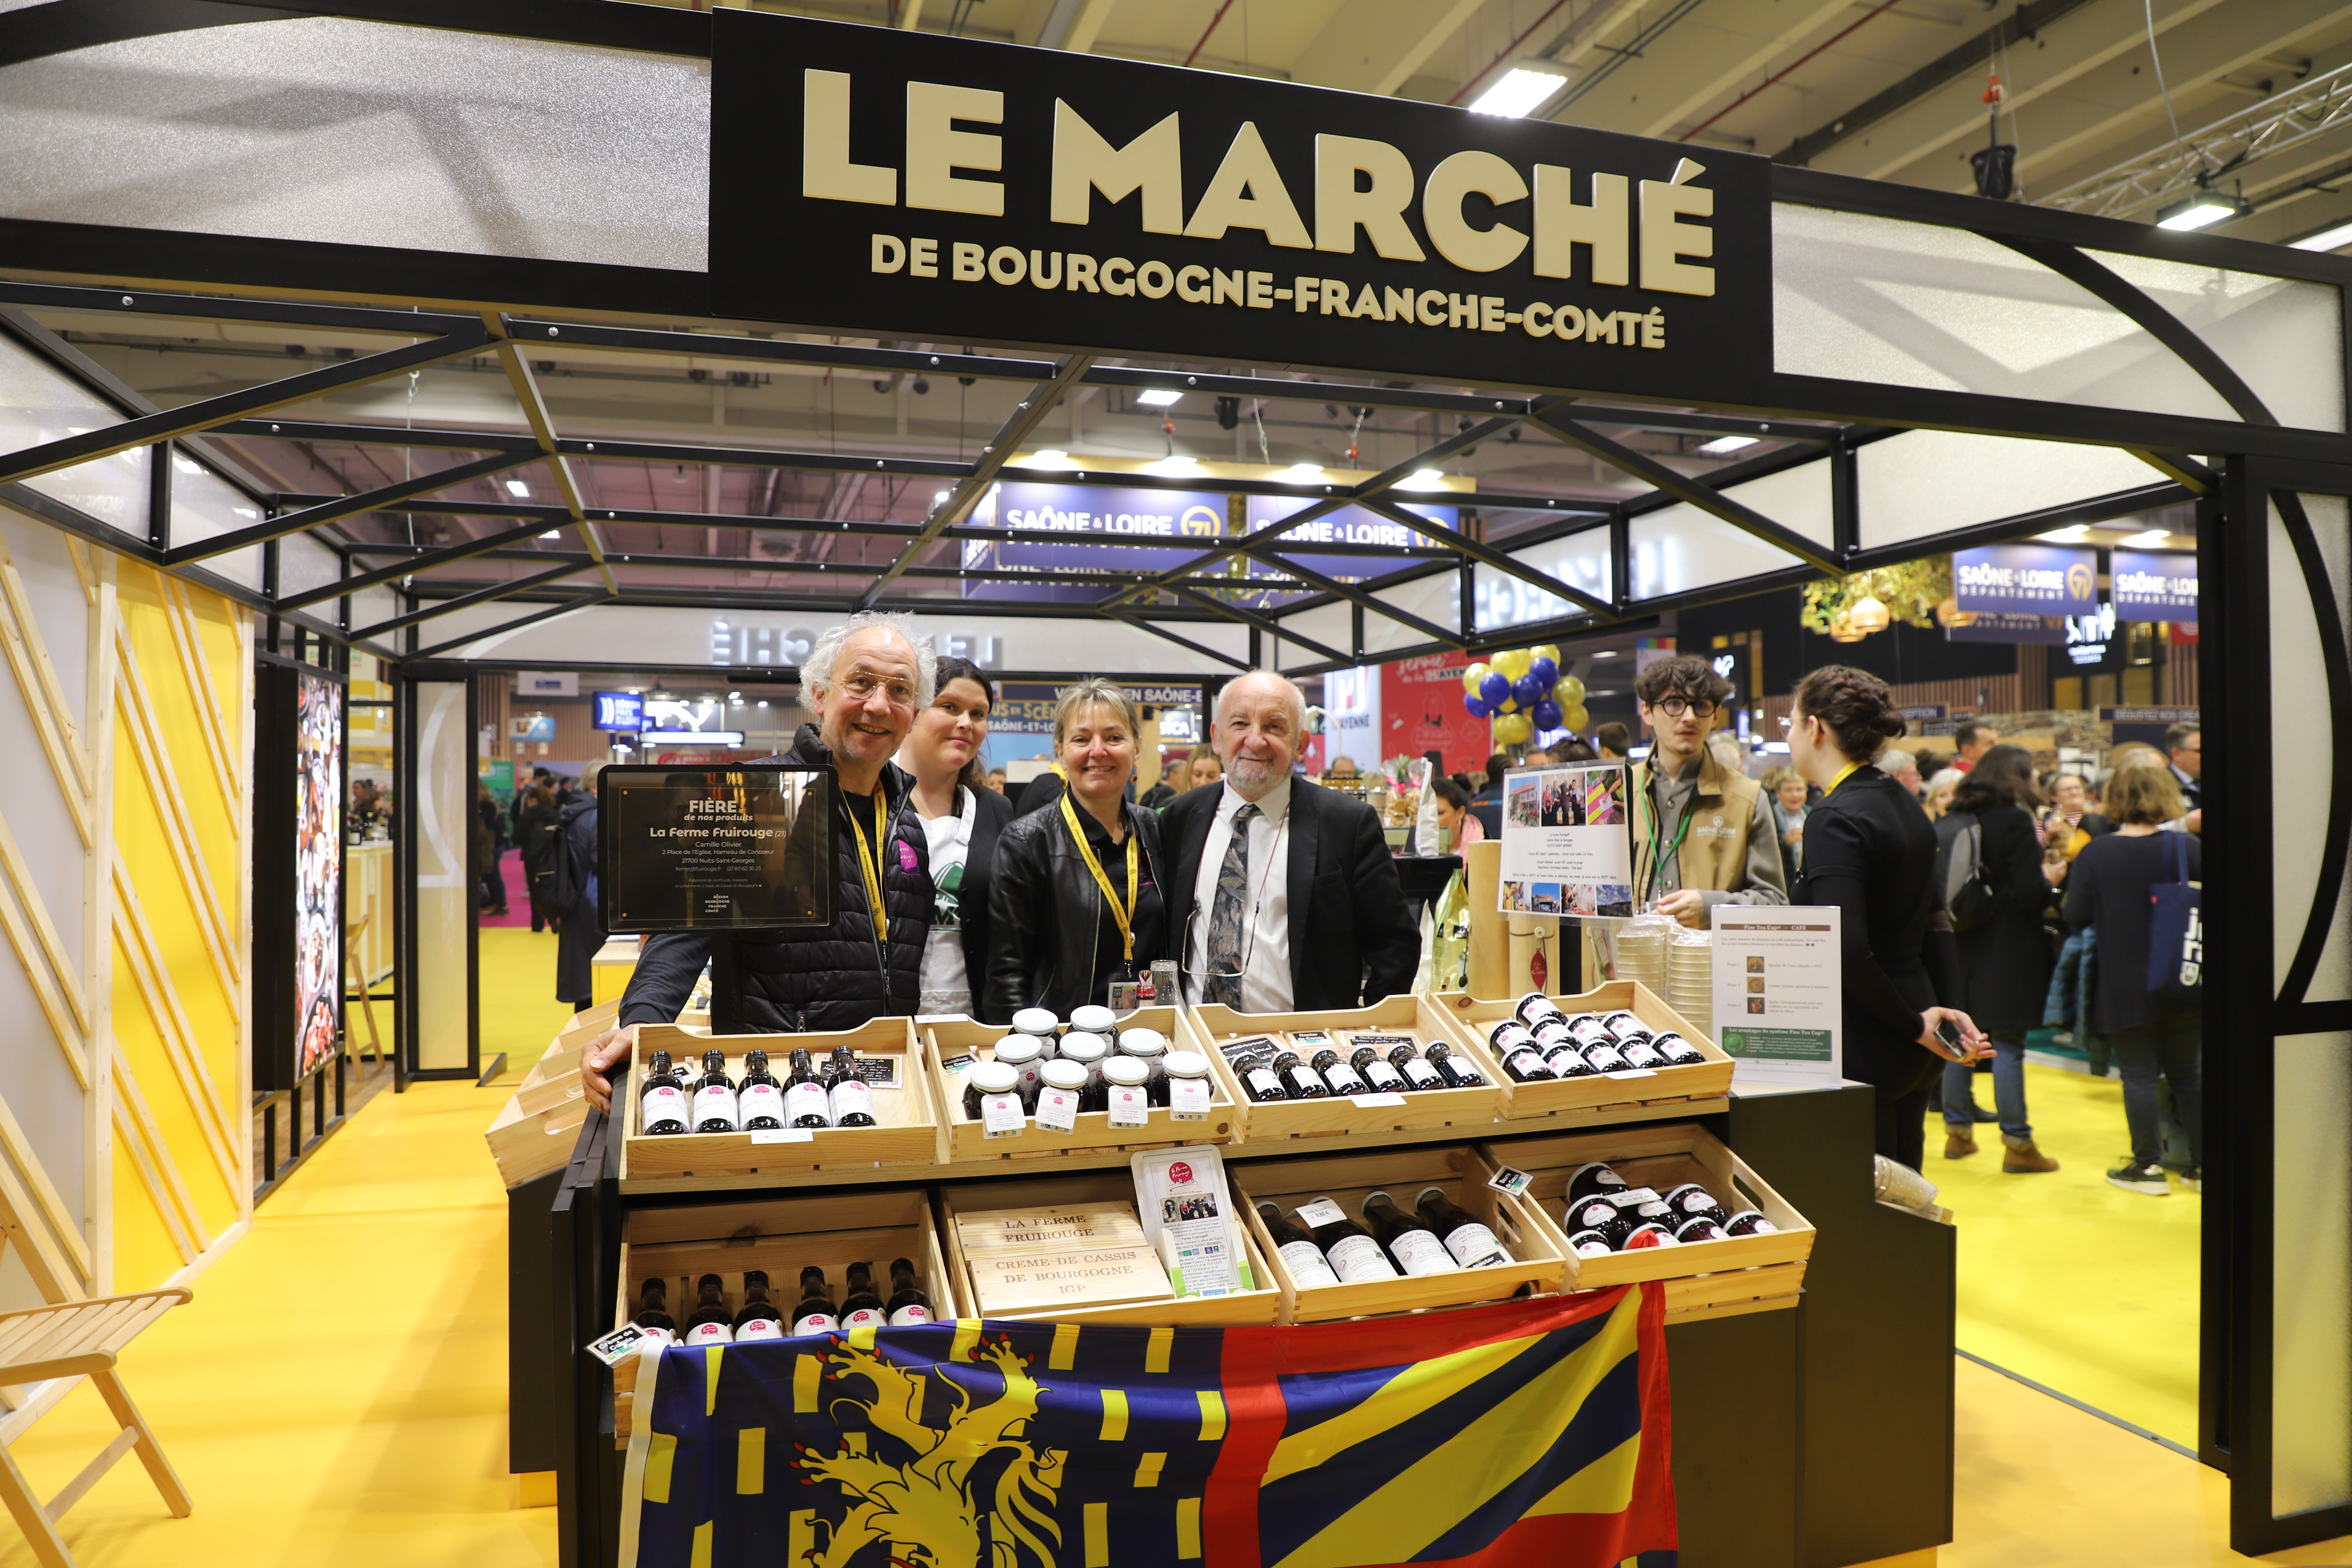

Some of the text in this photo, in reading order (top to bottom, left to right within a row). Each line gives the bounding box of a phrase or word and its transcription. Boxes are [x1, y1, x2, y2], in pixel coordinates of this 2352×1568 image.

[803, 68, 1715, 297] LE MARCHÉ
[871, 234, 1665, 349] DE BOURGOGNE-FRANCHE-COMTÉ
[1007, 505, 1091, 531] SAÔNE
[1105, 513, 1173, 535] LOIRE
[1346, 524, 1408, 547] LOIRE
[1958, 563, 2014, 586] SAÔNE
[2020, 569, 2064, 590] LOIRE
[2116, 571, 2198, 596] SAÔNE LOI
[2116, 594, 2195, 606] DEPARTEME
[1144, 687, 1202, 703] SAÔNE-E
[987, 721, 1055, 731] SAÔNE-ET-LO
[650, 828, 665, 837] La
[669, 828, 709, 837] Ferme
[713, 827, 773, 839] Fruirouge
[1251, 1044, 1272, 1053] local
[943, 1057, 968, 1065] Ketchup
[1034, 1215, 1086, 1226] FERME
[1005, 1229, 1094, 1242] FRUIROUGE
[1395, 1234, 1414, 1246] Nectar
[1449, 1228, 1467, 1242] Nectar
[1281, 1246, 1291, 1254] ctar
[1331, 1240, 1349, 1256] Nectar
[996, 1252, 1136, 1269] CREME DE CASSIS
[1004, 1266, 1133, 1283] DE BOURGOGNE
[1059, 1285, 1086, 1294] IGP
[598, 1335, 623, 1349] Crème
